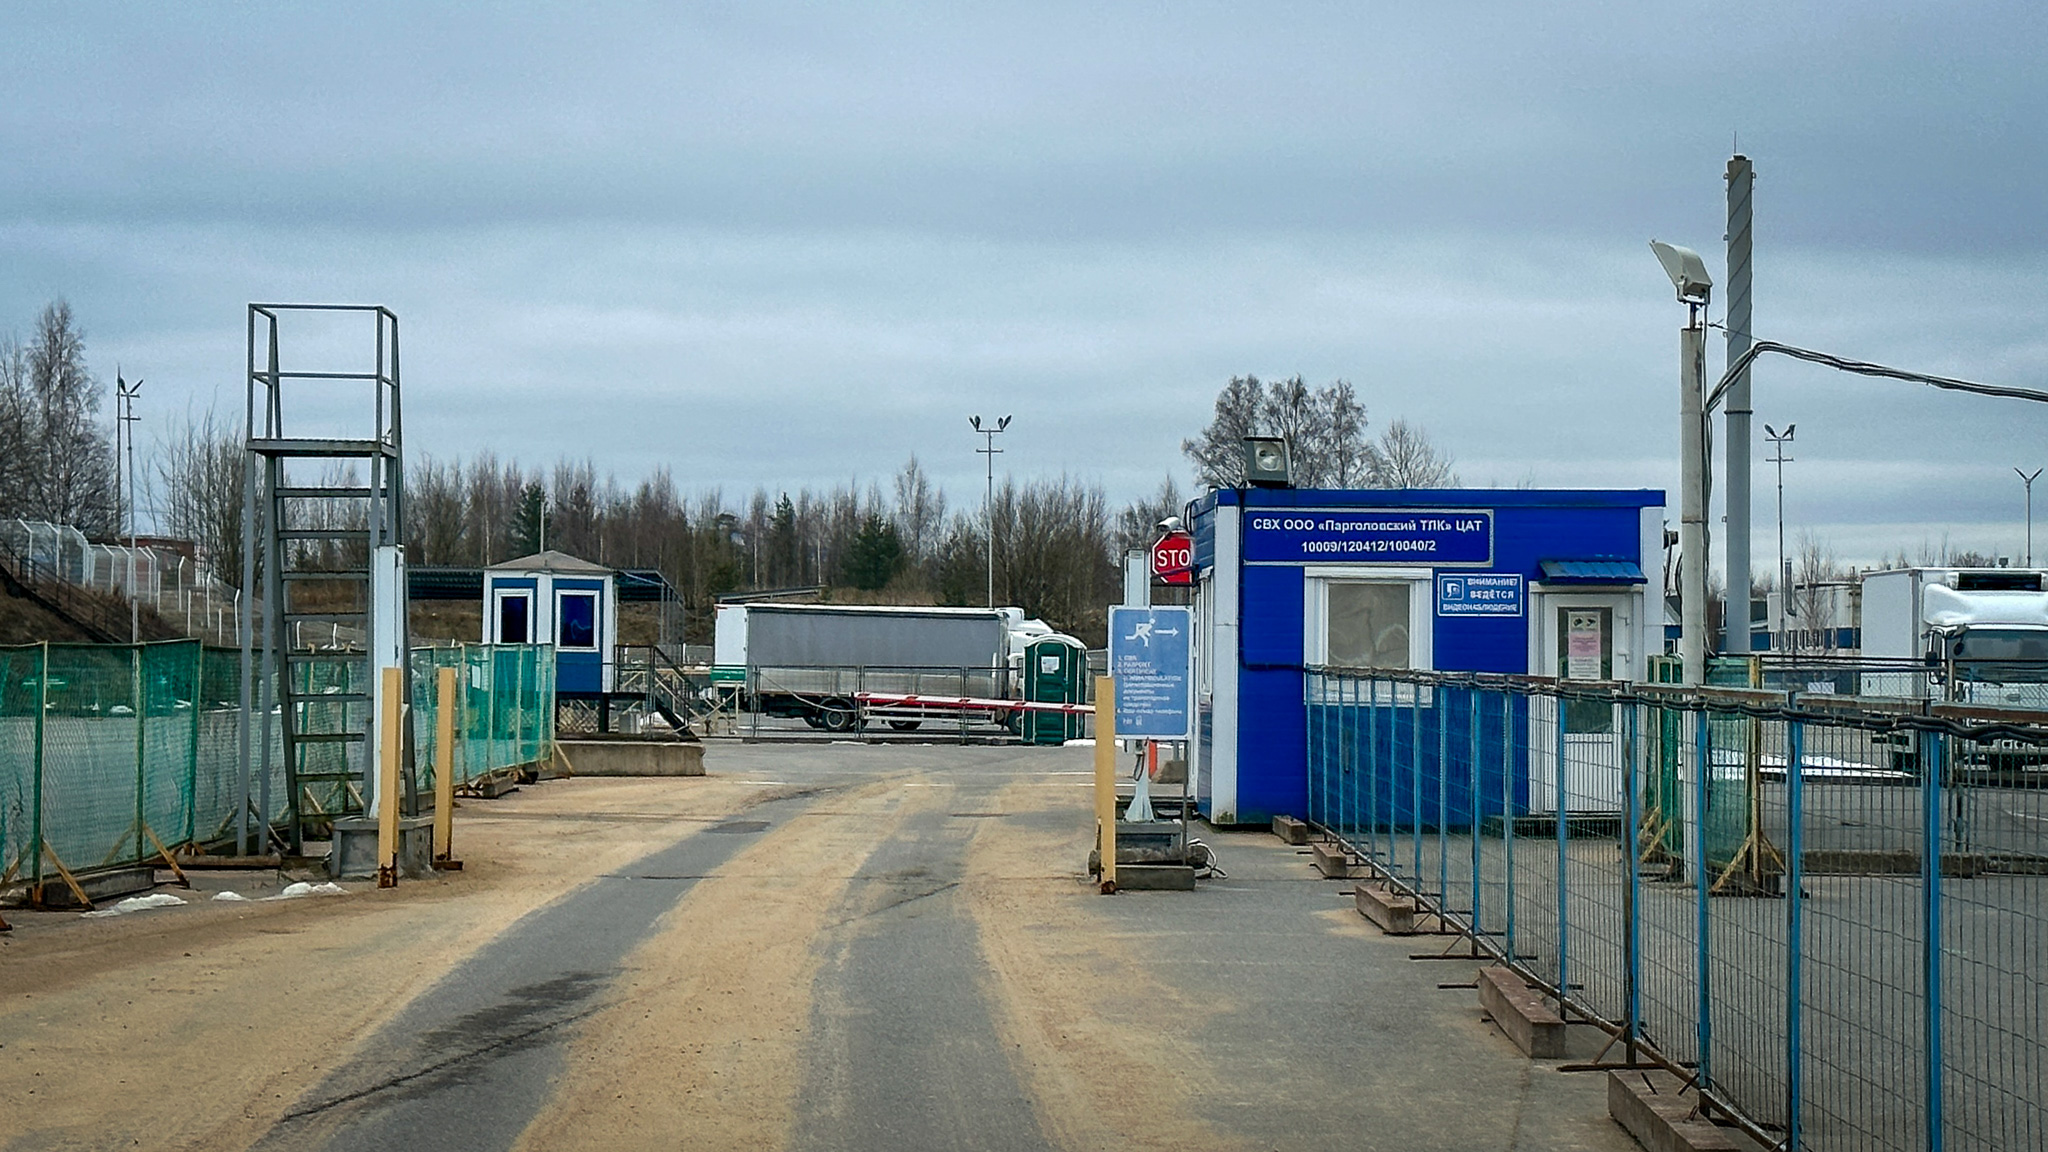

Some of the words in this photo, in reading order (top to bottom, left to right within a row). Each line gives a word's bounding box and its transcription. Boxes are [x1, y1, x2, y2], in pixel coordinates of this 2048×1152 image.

[1252, 518, 1281, 531] СВХ
[1283, 518, 1315, 531] ООО
[1318, 518, 1417, 533] «Парголовский
[1420, 518, 1452, 532] ТЛК»
[1455, 519, 1483, 533] ЦАТ
[1301, 540, 1437, 553] 10009/120412/10040/2
[1157, 549, 1190, 567] STO
